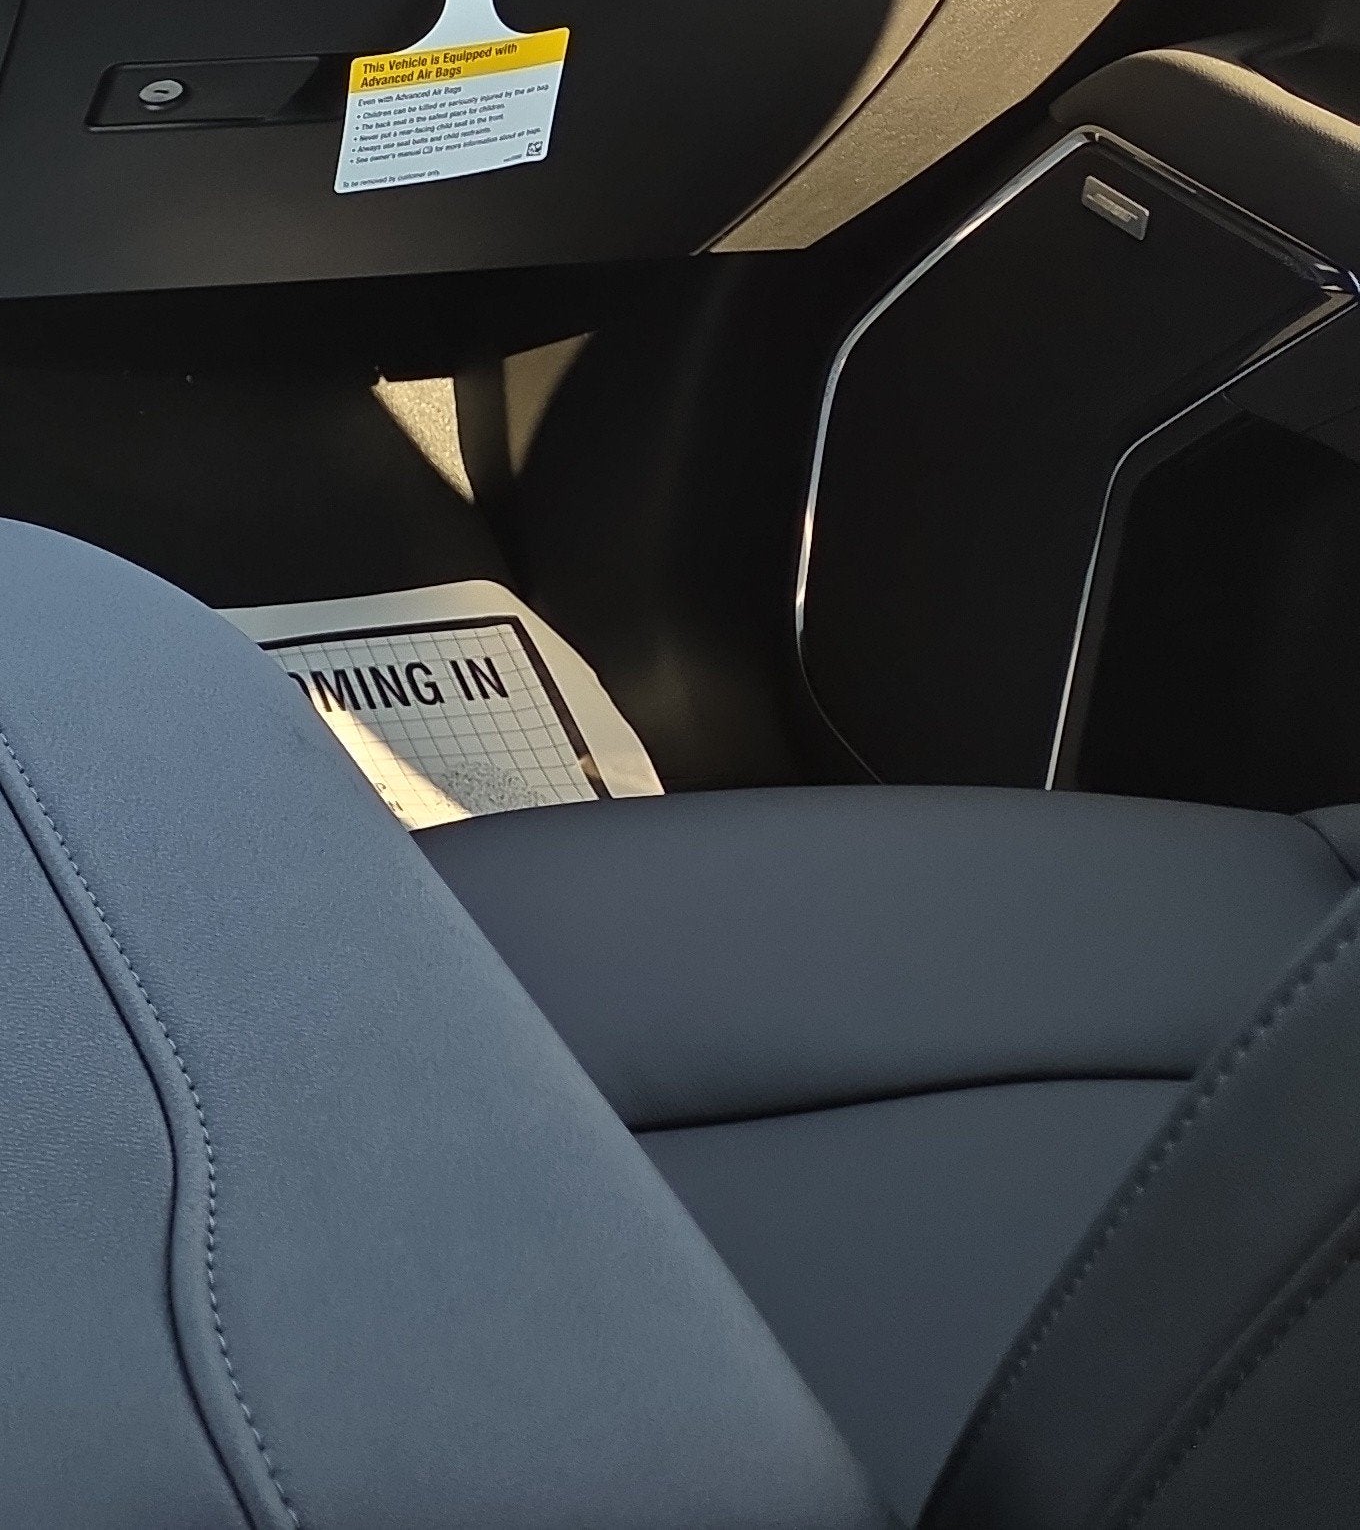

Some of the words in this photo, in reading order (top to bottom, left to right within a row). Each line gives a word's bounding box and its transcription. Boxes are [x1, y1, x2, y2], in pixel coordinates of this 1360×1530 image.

[363, 63, 384, 74] This
[388, 56, 427, 71] Vehicle
[430, 55, 440, 64] is
[443, 46, 492, 64] Equipped
[495, 42, 517, 56] with
[360, 71, 414, 88] Advanced
[416, 69, 433, 80] Air
[435, 66, 462, 78] Bags
[449, 656, 509, 701] IN
